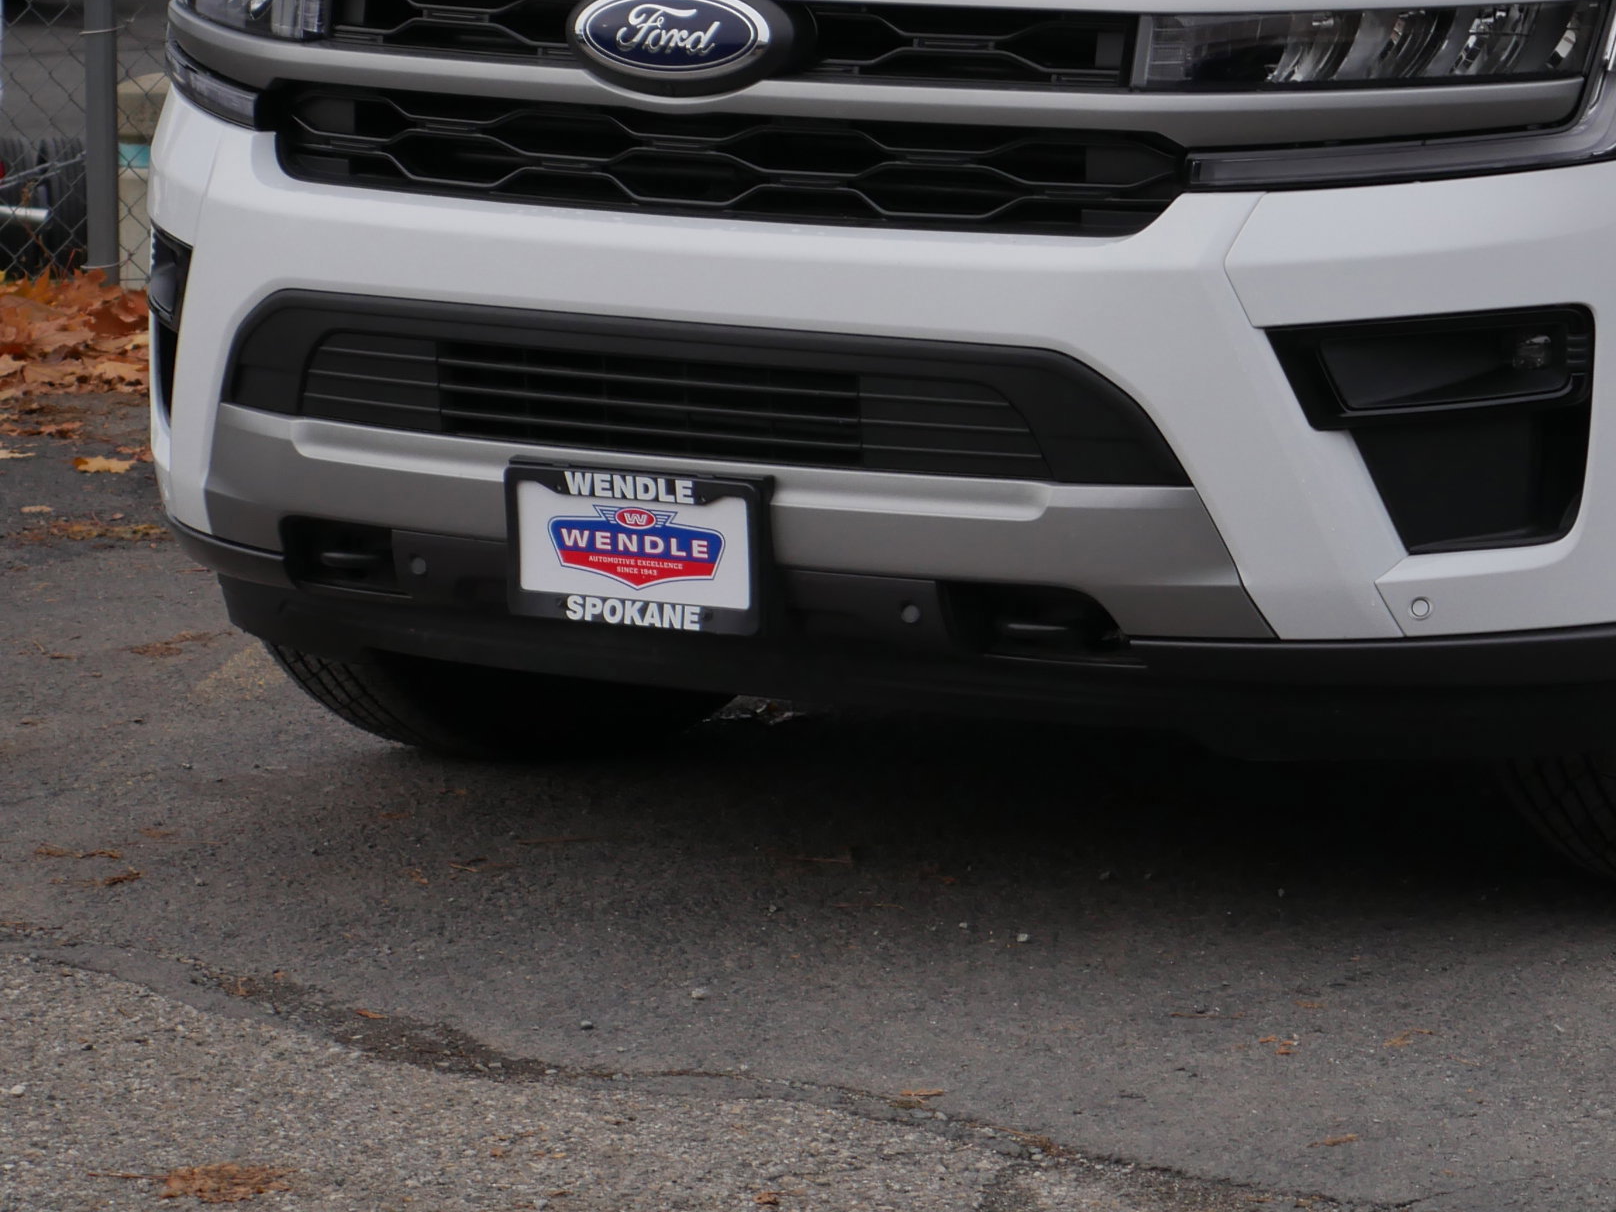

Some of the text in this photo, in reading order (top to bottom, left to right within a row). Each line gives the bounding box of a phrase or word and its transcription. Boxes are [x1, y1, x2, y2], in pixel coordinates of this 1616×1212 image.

[616, 3, 720, 57] Ford
[564, 471, 694, 504] WENDLE
[560, 527, 709, 560] WENDLE
[588, 555, 684, 570] AUTOMOTIVE EXCELLENCE
[616, 566, 658, 576] SINCE 1943
[566, 595, 700, 631] SPOKANE
